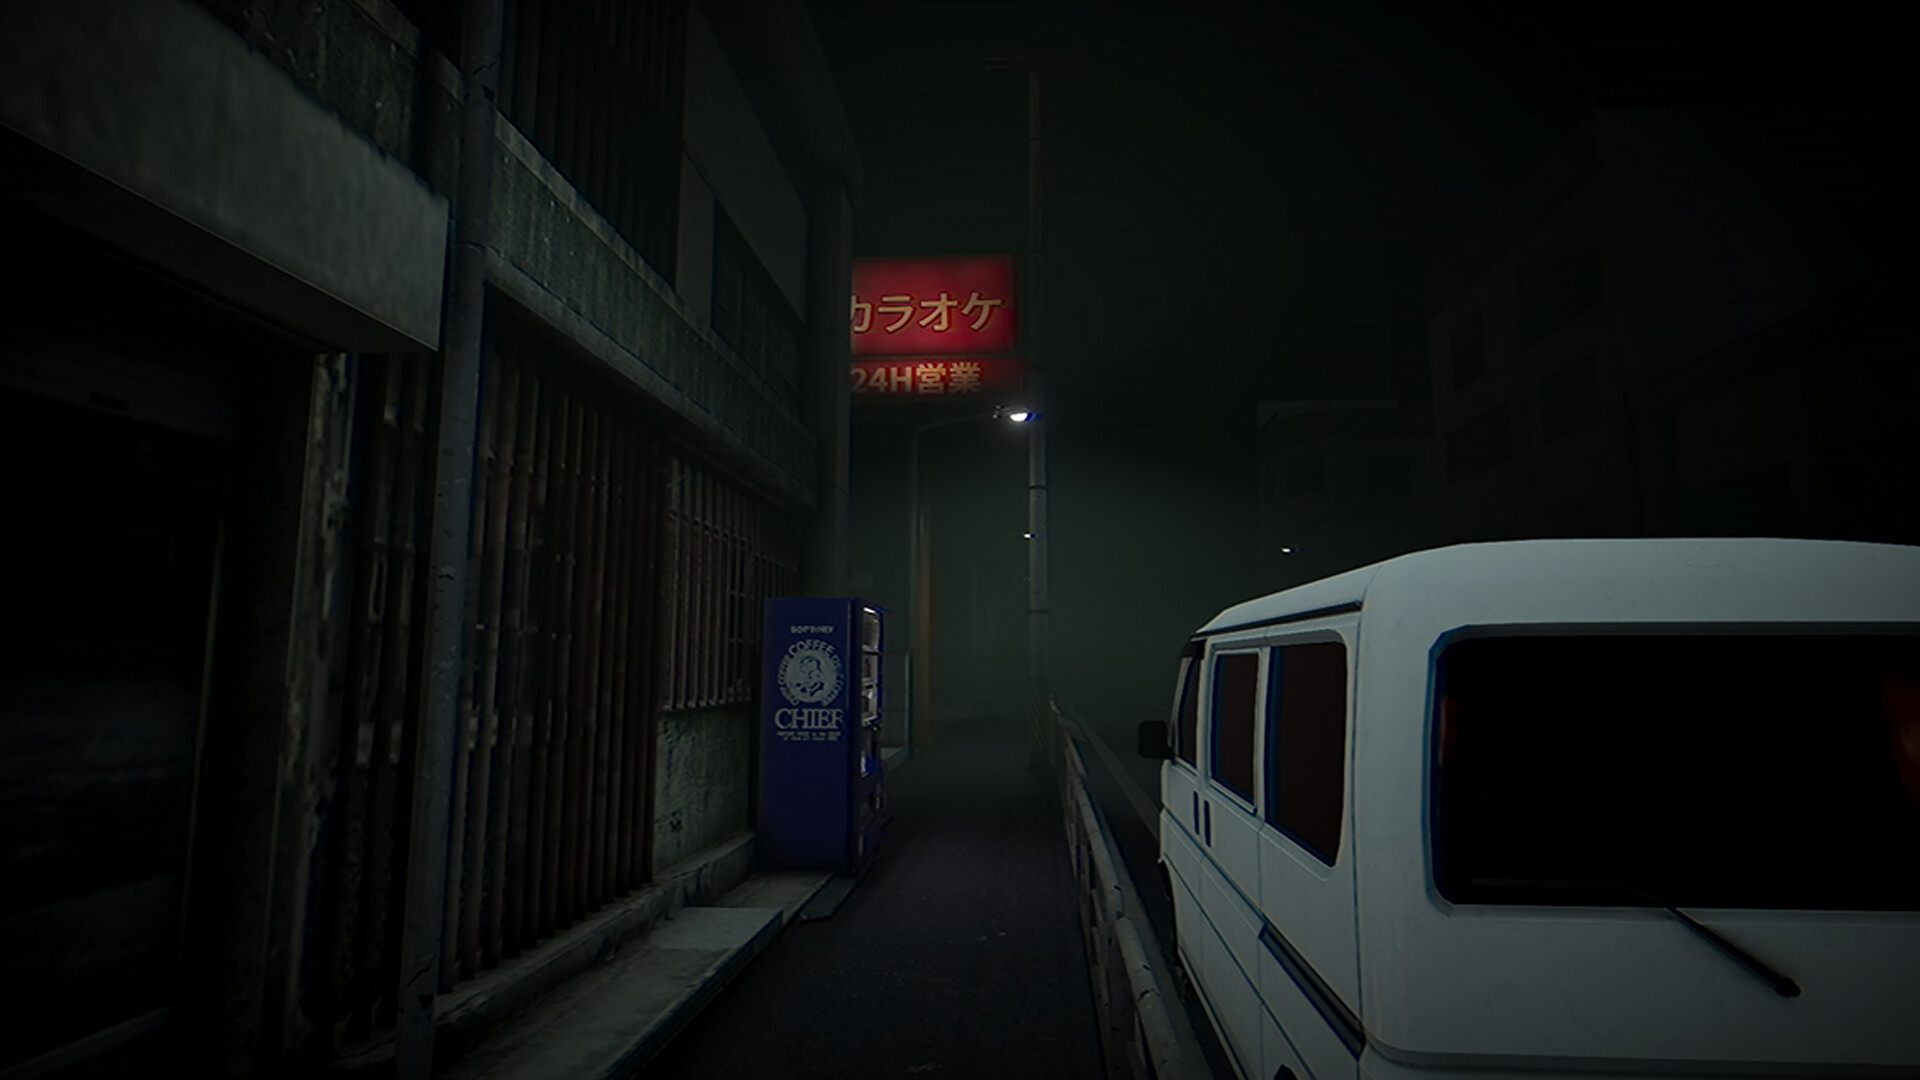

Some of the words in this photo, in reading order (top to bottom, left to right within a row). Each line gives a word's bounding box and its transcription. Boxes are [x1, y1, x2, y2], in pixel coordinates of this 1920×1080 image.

[850, 292, 1003, 334] カラオケ
[788, 638, 836, 656] COFFEE
[774, 707, 844, 730] CHIEF
